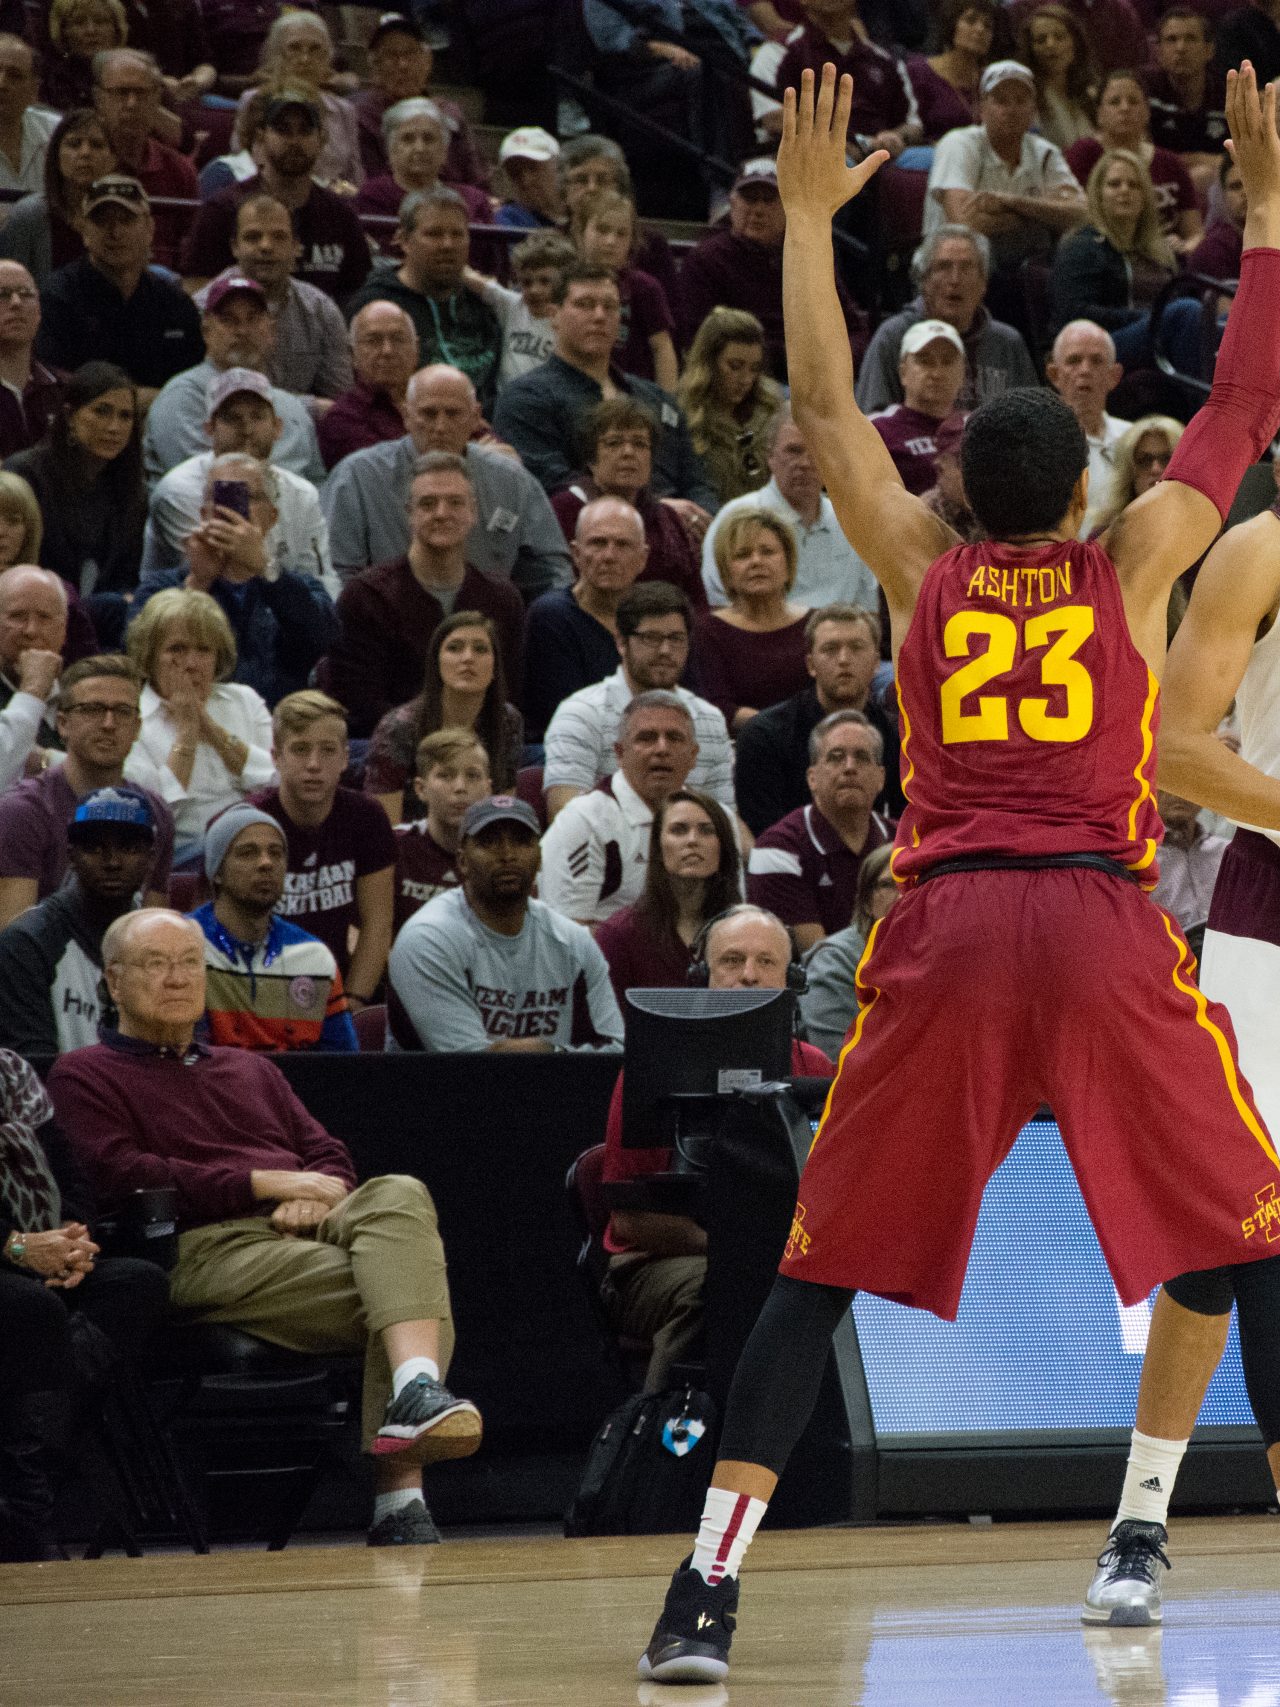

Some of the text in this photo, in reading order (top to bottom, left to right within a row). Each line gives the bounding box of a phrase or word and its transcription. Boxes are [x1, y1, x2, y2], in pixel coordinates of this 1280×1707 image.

[967, 562, 1072, 606] ASHTON
[942, 605, 1095, 744] 23
[1139, 1482, 1163, 1493] adidas
